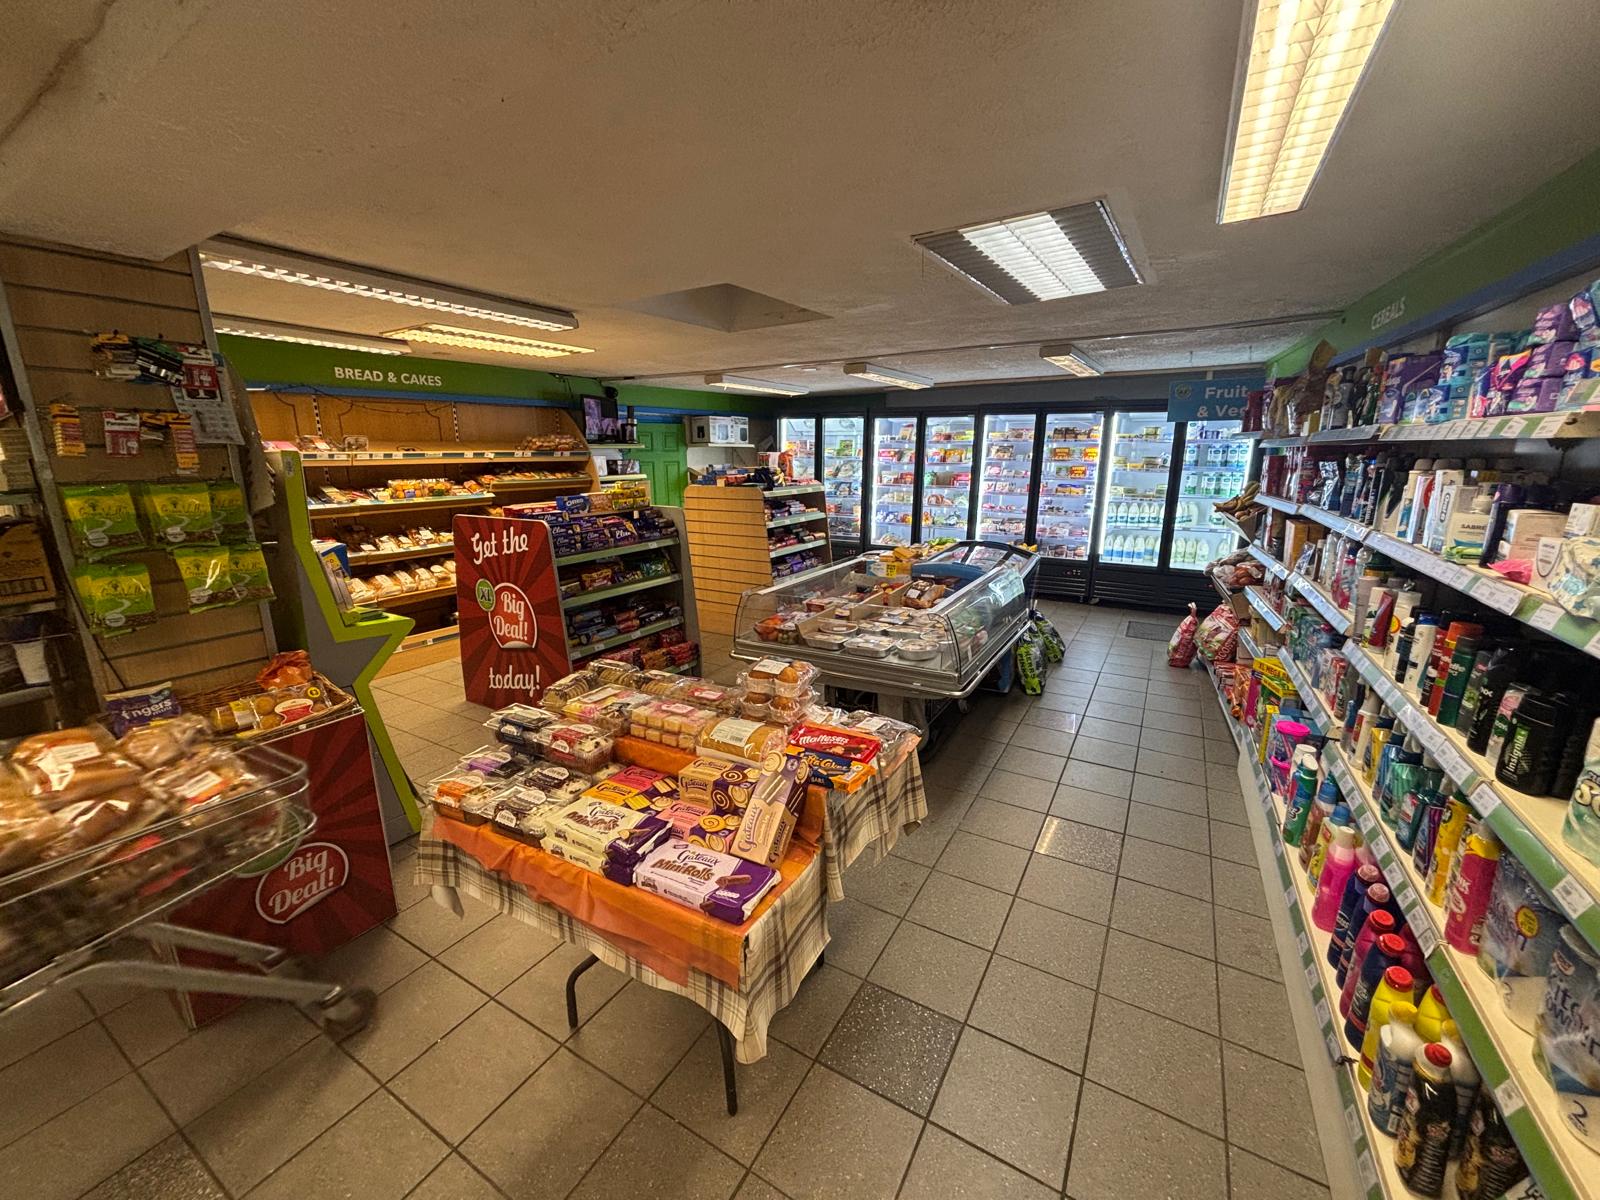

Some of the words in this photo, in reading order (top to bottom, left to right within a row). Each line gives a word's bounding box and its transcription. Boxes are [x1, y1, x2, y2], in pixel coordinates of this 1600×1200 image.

[1370, 295, 1406, 330] CEREALS
[334, 366, 384, 382] BREAD
[387, 371, 398, 384] &
[400, 372, 442, 387] CAKES
[1204, 385, 1248, 399] Fruit
[1196, 405, 1209, 418] &
[471, 532, 498, 565] Get
[502, 526, 529, 555] the
[480, 587, 492, 602] XL
[501, 591, 525, 620] Big
[494, 615, 528, 641] Deal!
[488, 665, 540, 698] today!
[800, 734, 849, 745] Maltesers
[284, 849, 328, 881] Big
[268, 866, 335, 915] Deal!
